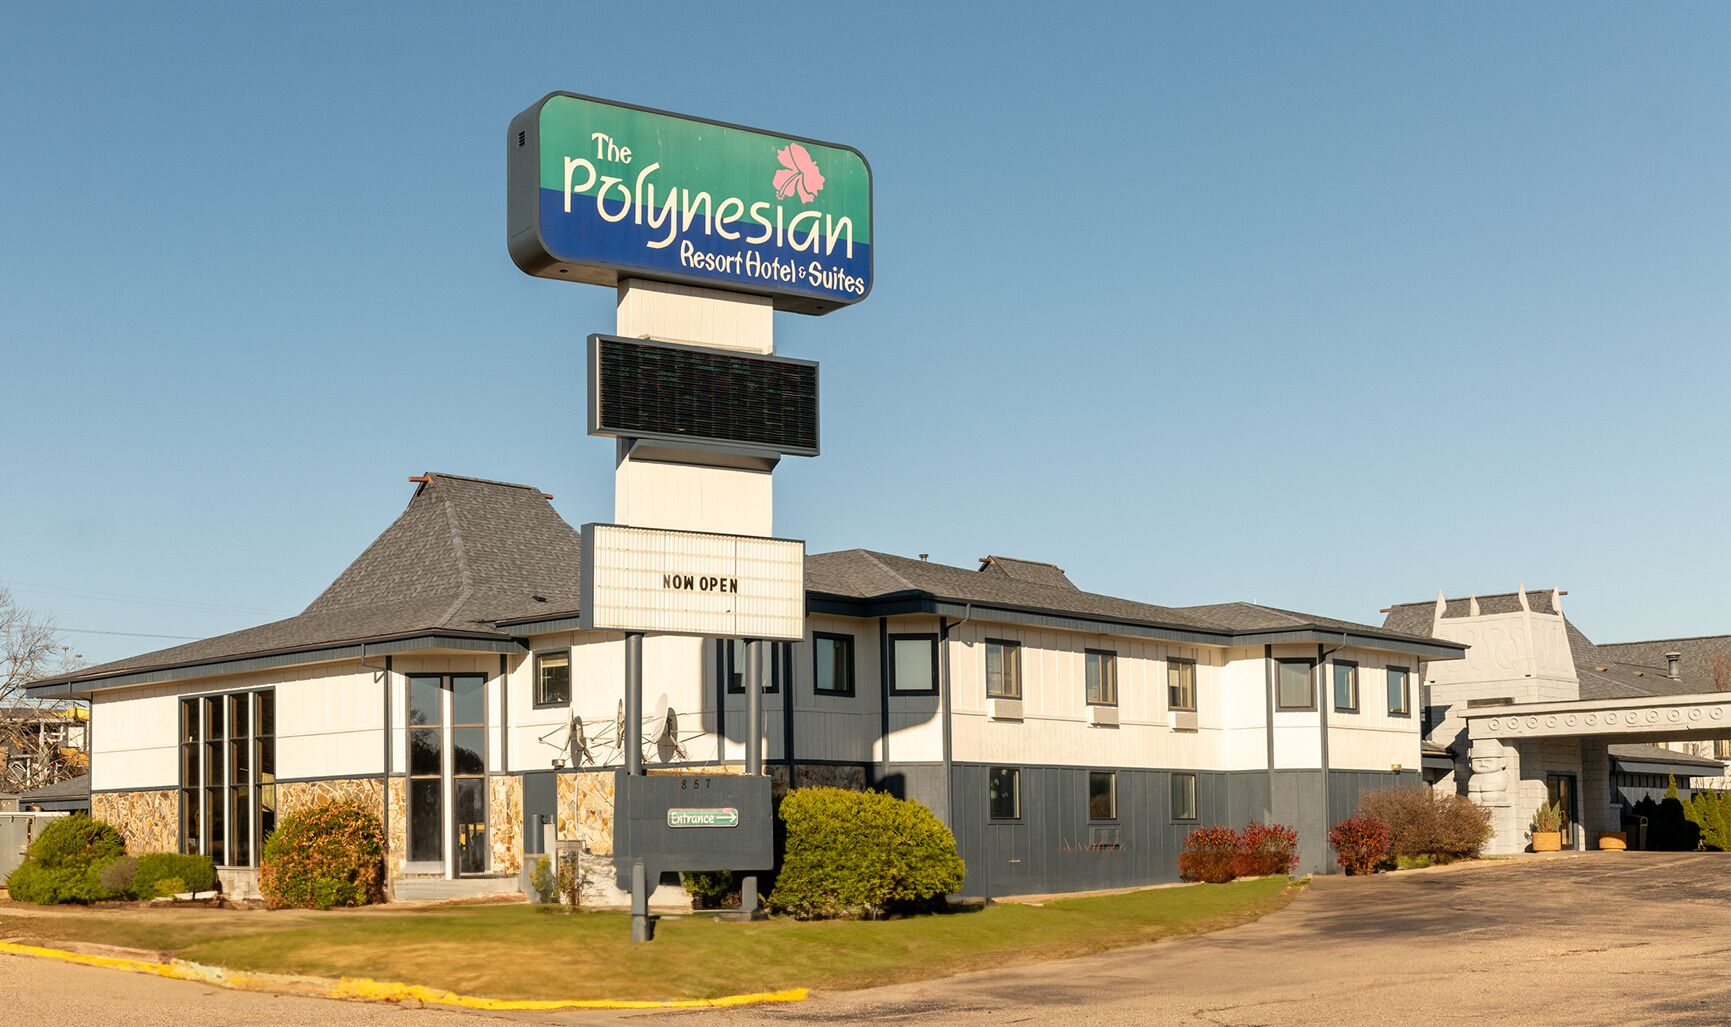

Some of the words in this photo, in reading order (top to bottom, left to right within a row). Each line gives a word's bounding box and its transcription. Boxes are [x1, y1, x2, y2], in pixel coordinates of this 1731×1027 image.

[591, 132, 632, 165] The
[564, 156, 853, 259] Polynesian
[680, 239, 743, 275] Resort
[745, 250, 796, 283] Hotel
[798, 265, 807, 279] &
[808, 262, 865, 295] Suites
[663, 574, 694, 591] NOW
[700, 576, 738, 594] OPEN
[671, 811, 715, 824] Entrance
